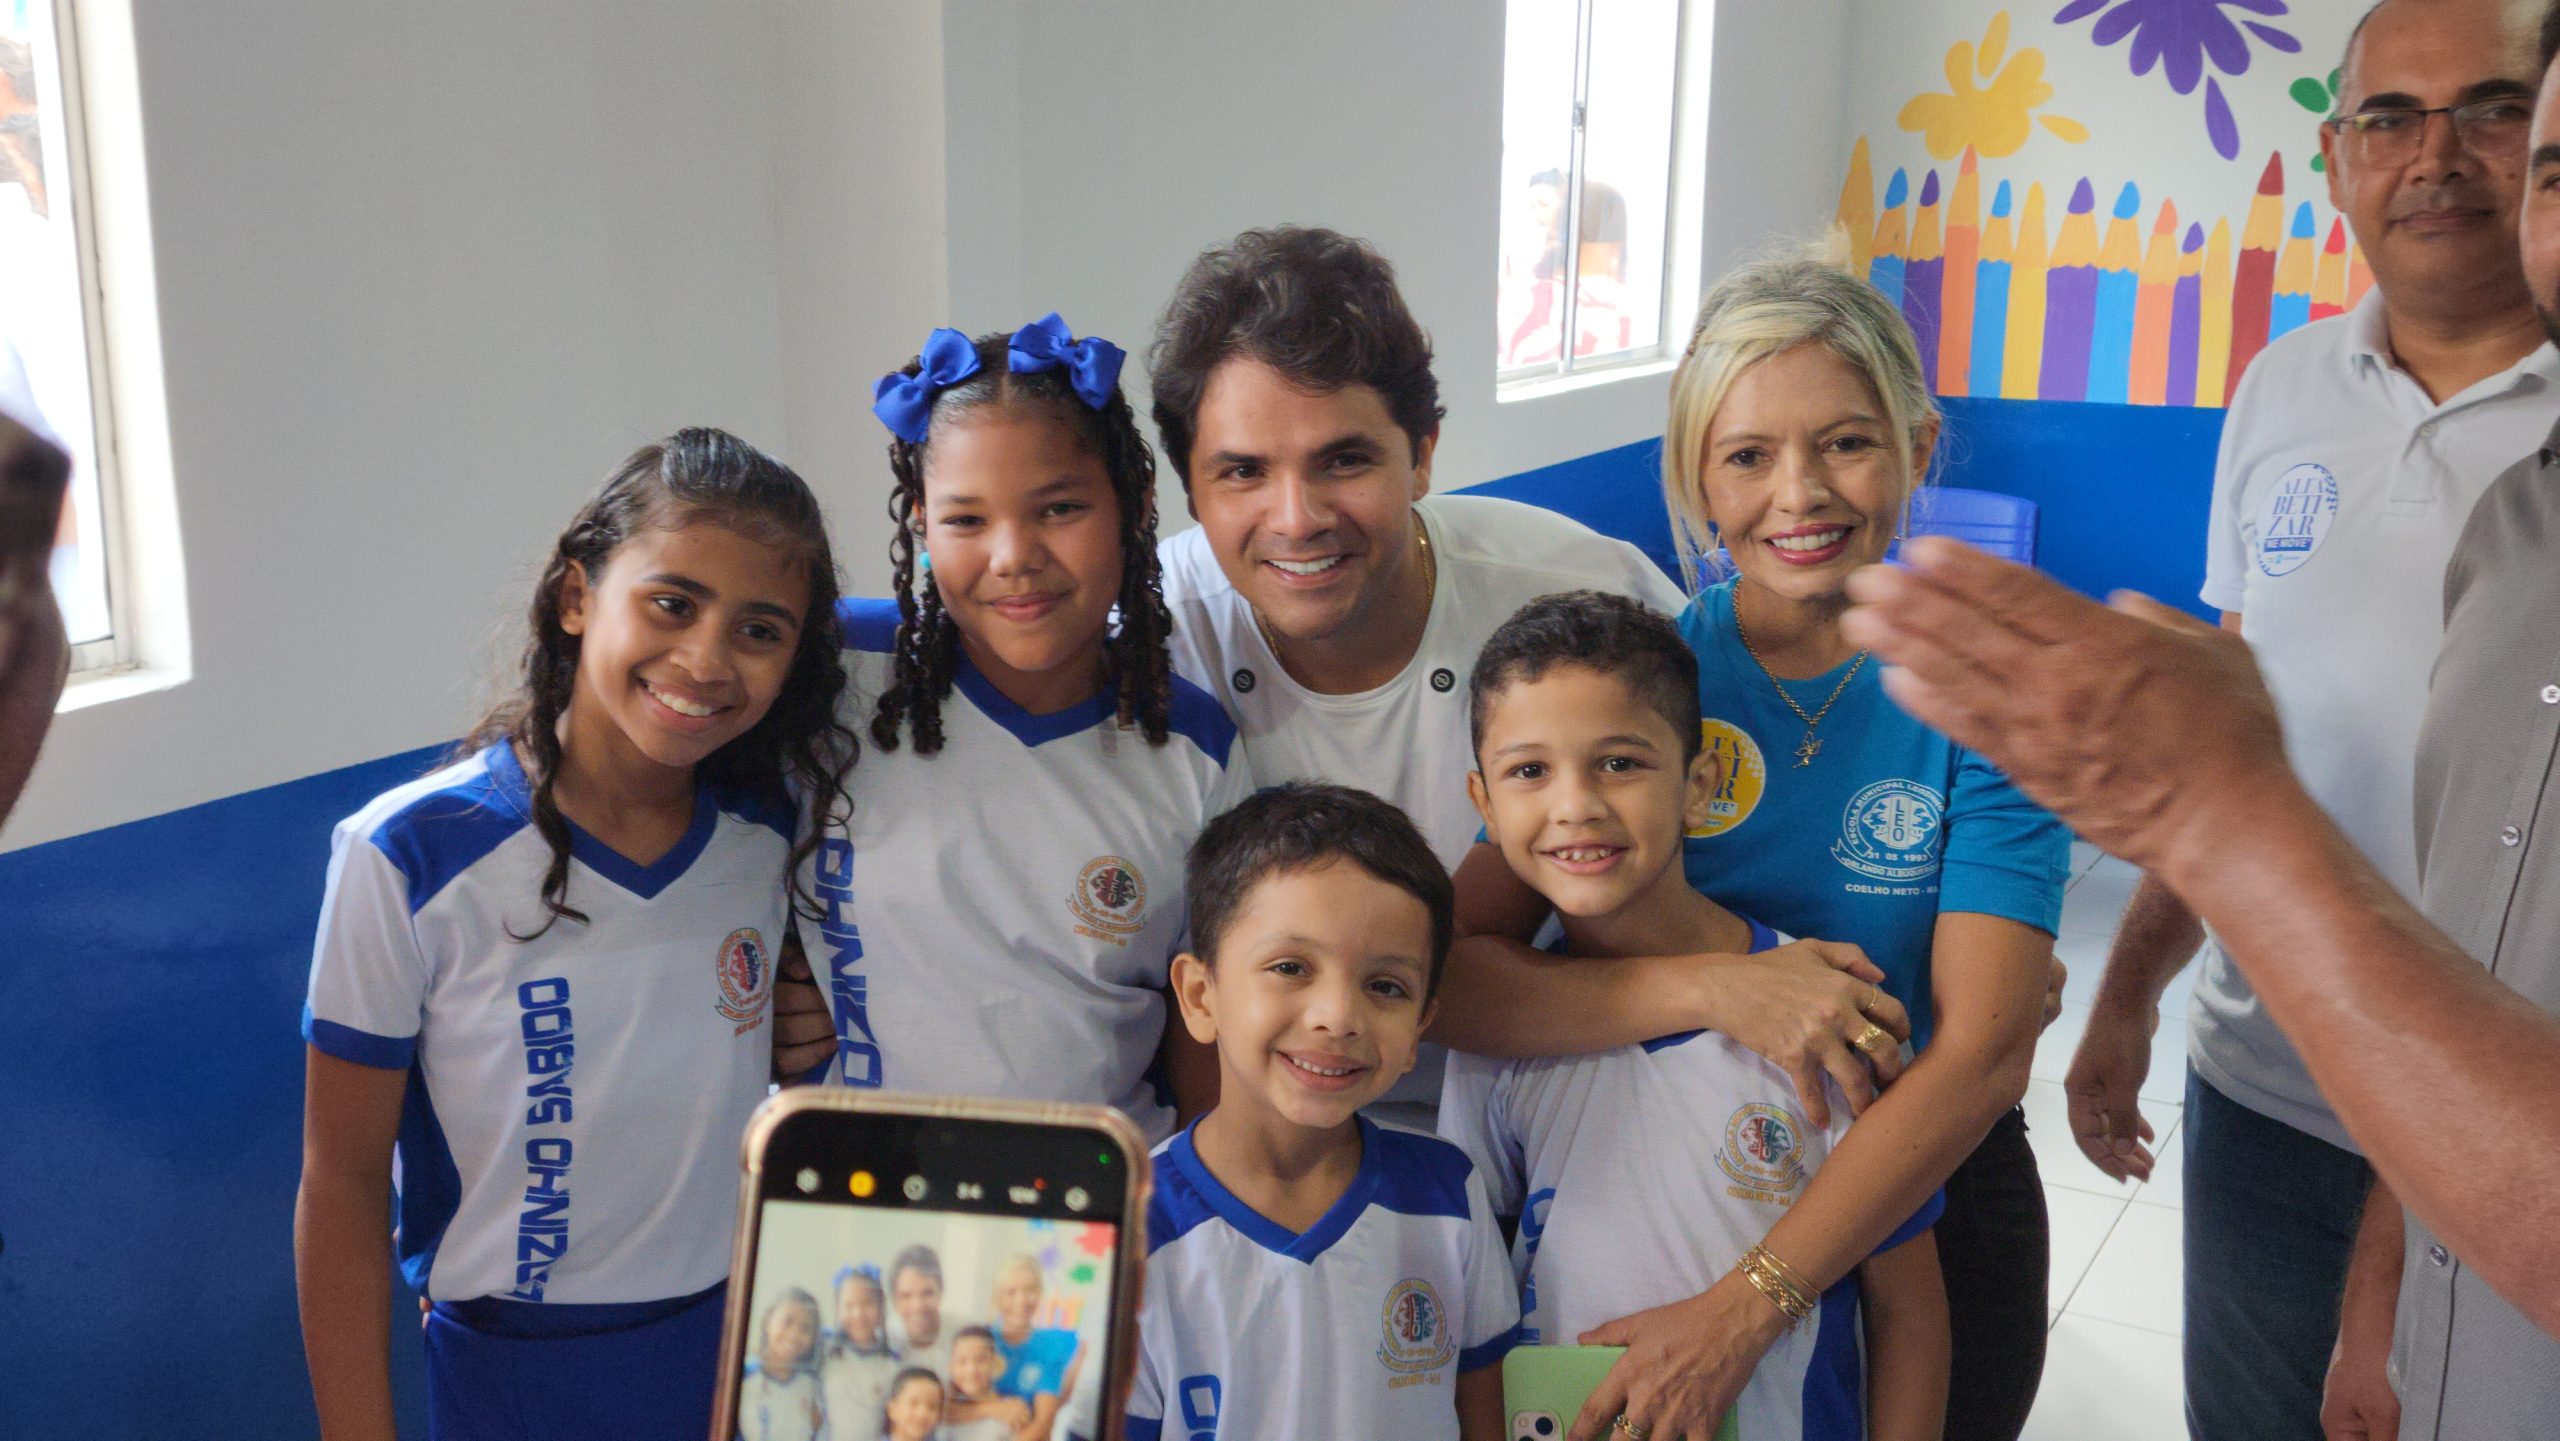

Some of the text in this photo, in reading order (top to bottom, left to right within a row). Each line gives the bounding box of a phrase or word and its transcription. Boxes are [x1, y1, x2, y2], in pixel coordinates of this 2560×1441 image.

[1847, 809, 1861, 845] ESCOLA
[1856, 782, 1905, 808] MUNICIPAL
[1893, 799, 1905, 842] LEO
[1845, 883, 1890, 895] COELHO
[1892, 887, 1920, 896] NETO
[815, 838, 883, 1088] OZINHO
[518, 977, 575, 1126] SABIDO
